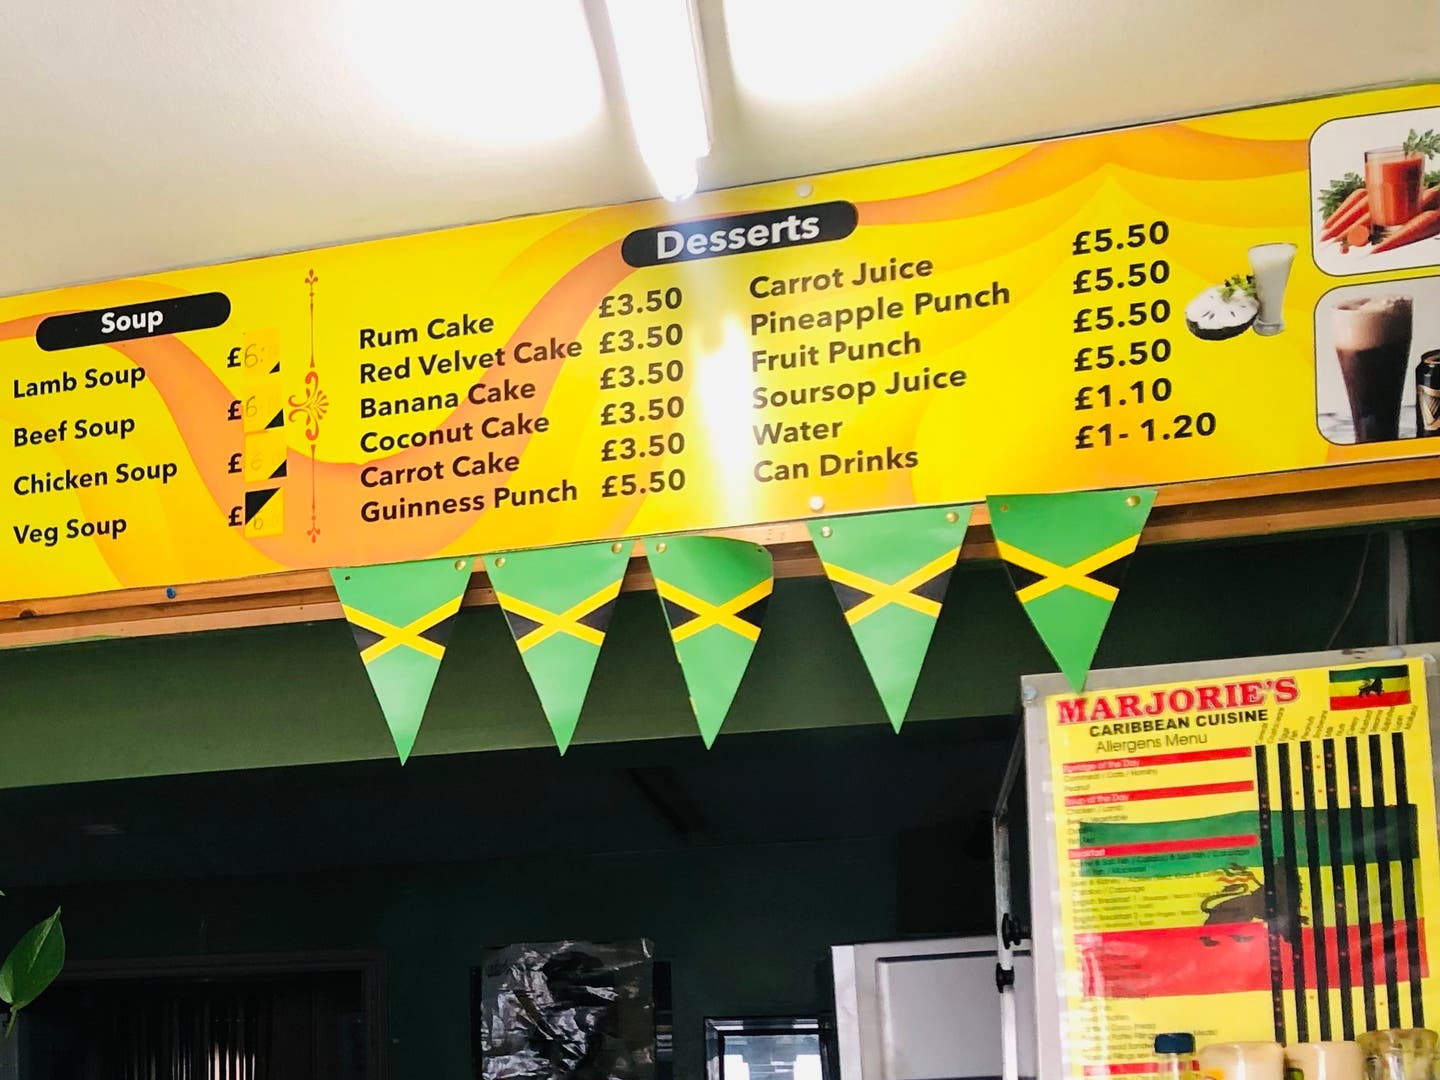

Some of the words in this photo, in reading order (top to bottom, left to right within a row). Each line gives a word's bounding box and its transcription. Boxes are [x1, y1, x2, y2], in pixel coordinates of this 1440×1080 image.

[657, 215, 820, 260] Desserts
[1073, 221, 1169, 255] £5.50
[750, 269, 842, 298] Carrot
[853, 258, 932, 285] Juice
[1073, 260, 1169, 294] £5.50
[599, 287, 682, 318] £3.50
[752, 297, 903, 335] Pineapple
[916, 282, 1009, 315] Punch
[1074, 299, 1170, 333] £5.50
[101, 309, 164, 334] Soup
[360, 328, 417, 349] Rum
[428, 314, 493, 339] Cake
[600, 324, 682, 353] £3.50
[361, 357, 410, 383] Red
[418, 349, 505, 375] Velvet
[514, 338, 581, 363] Cake
[753, 345, 818, 371] Fruit
[830, 332, 920, 363] Punch
[1075, 339, 1171, 371] £5.50
[14, 372, 77, 398] Lamb
[85, 367, 145, 388] Soup
[601, 360, 683, 389] £3.50
[753, 381, 876, 409] Soursop
[886, 368, 966, 394] Juice
[361, 393, 458, 418] Banana
[468, 379, 535, 404] Cake
[601, 397, 683, 425] £3.50
[1075, 378, 1171, 410] £1.10
[15, 420, 67, 447] Beef
[75, 419, 135, 439] Soup
[361, 423, 472, 452] Coconut
[482, 413, 549, 438] Cake
[602, 433, 684, 461] £3.50
[752, 421, 843, 445] Water
[1076, 424, 1128, 449] £1-
[1141, 412, 1216, 441] 1.20
[14, 470, 107, 495] Chicken
[116, 463, 177, 484] Soup
[361, 462, 443, 487] Carrot
[453, 452, 519, 477] Cake
[753, 460, 809, 482] Can
[821, 447, 917, 476] Drinks
[602, 469, 684, 497] £5.50
[361, 496, 484, 522] Guinness
[495, 480, 576, 508] Punch
[13, 525, 58, 547] Veg
[67, 519, 126, 539] Soup
[1058, 676, 1299, 725] MARJORIE'S
[1089, 716, 1190, 737] CARIBBEAN
[1196, 709, 1268, 727] CUISINE
[1096, 738, 1162, 754] Allergens
[1166, 732, 1208, 747] Menu
